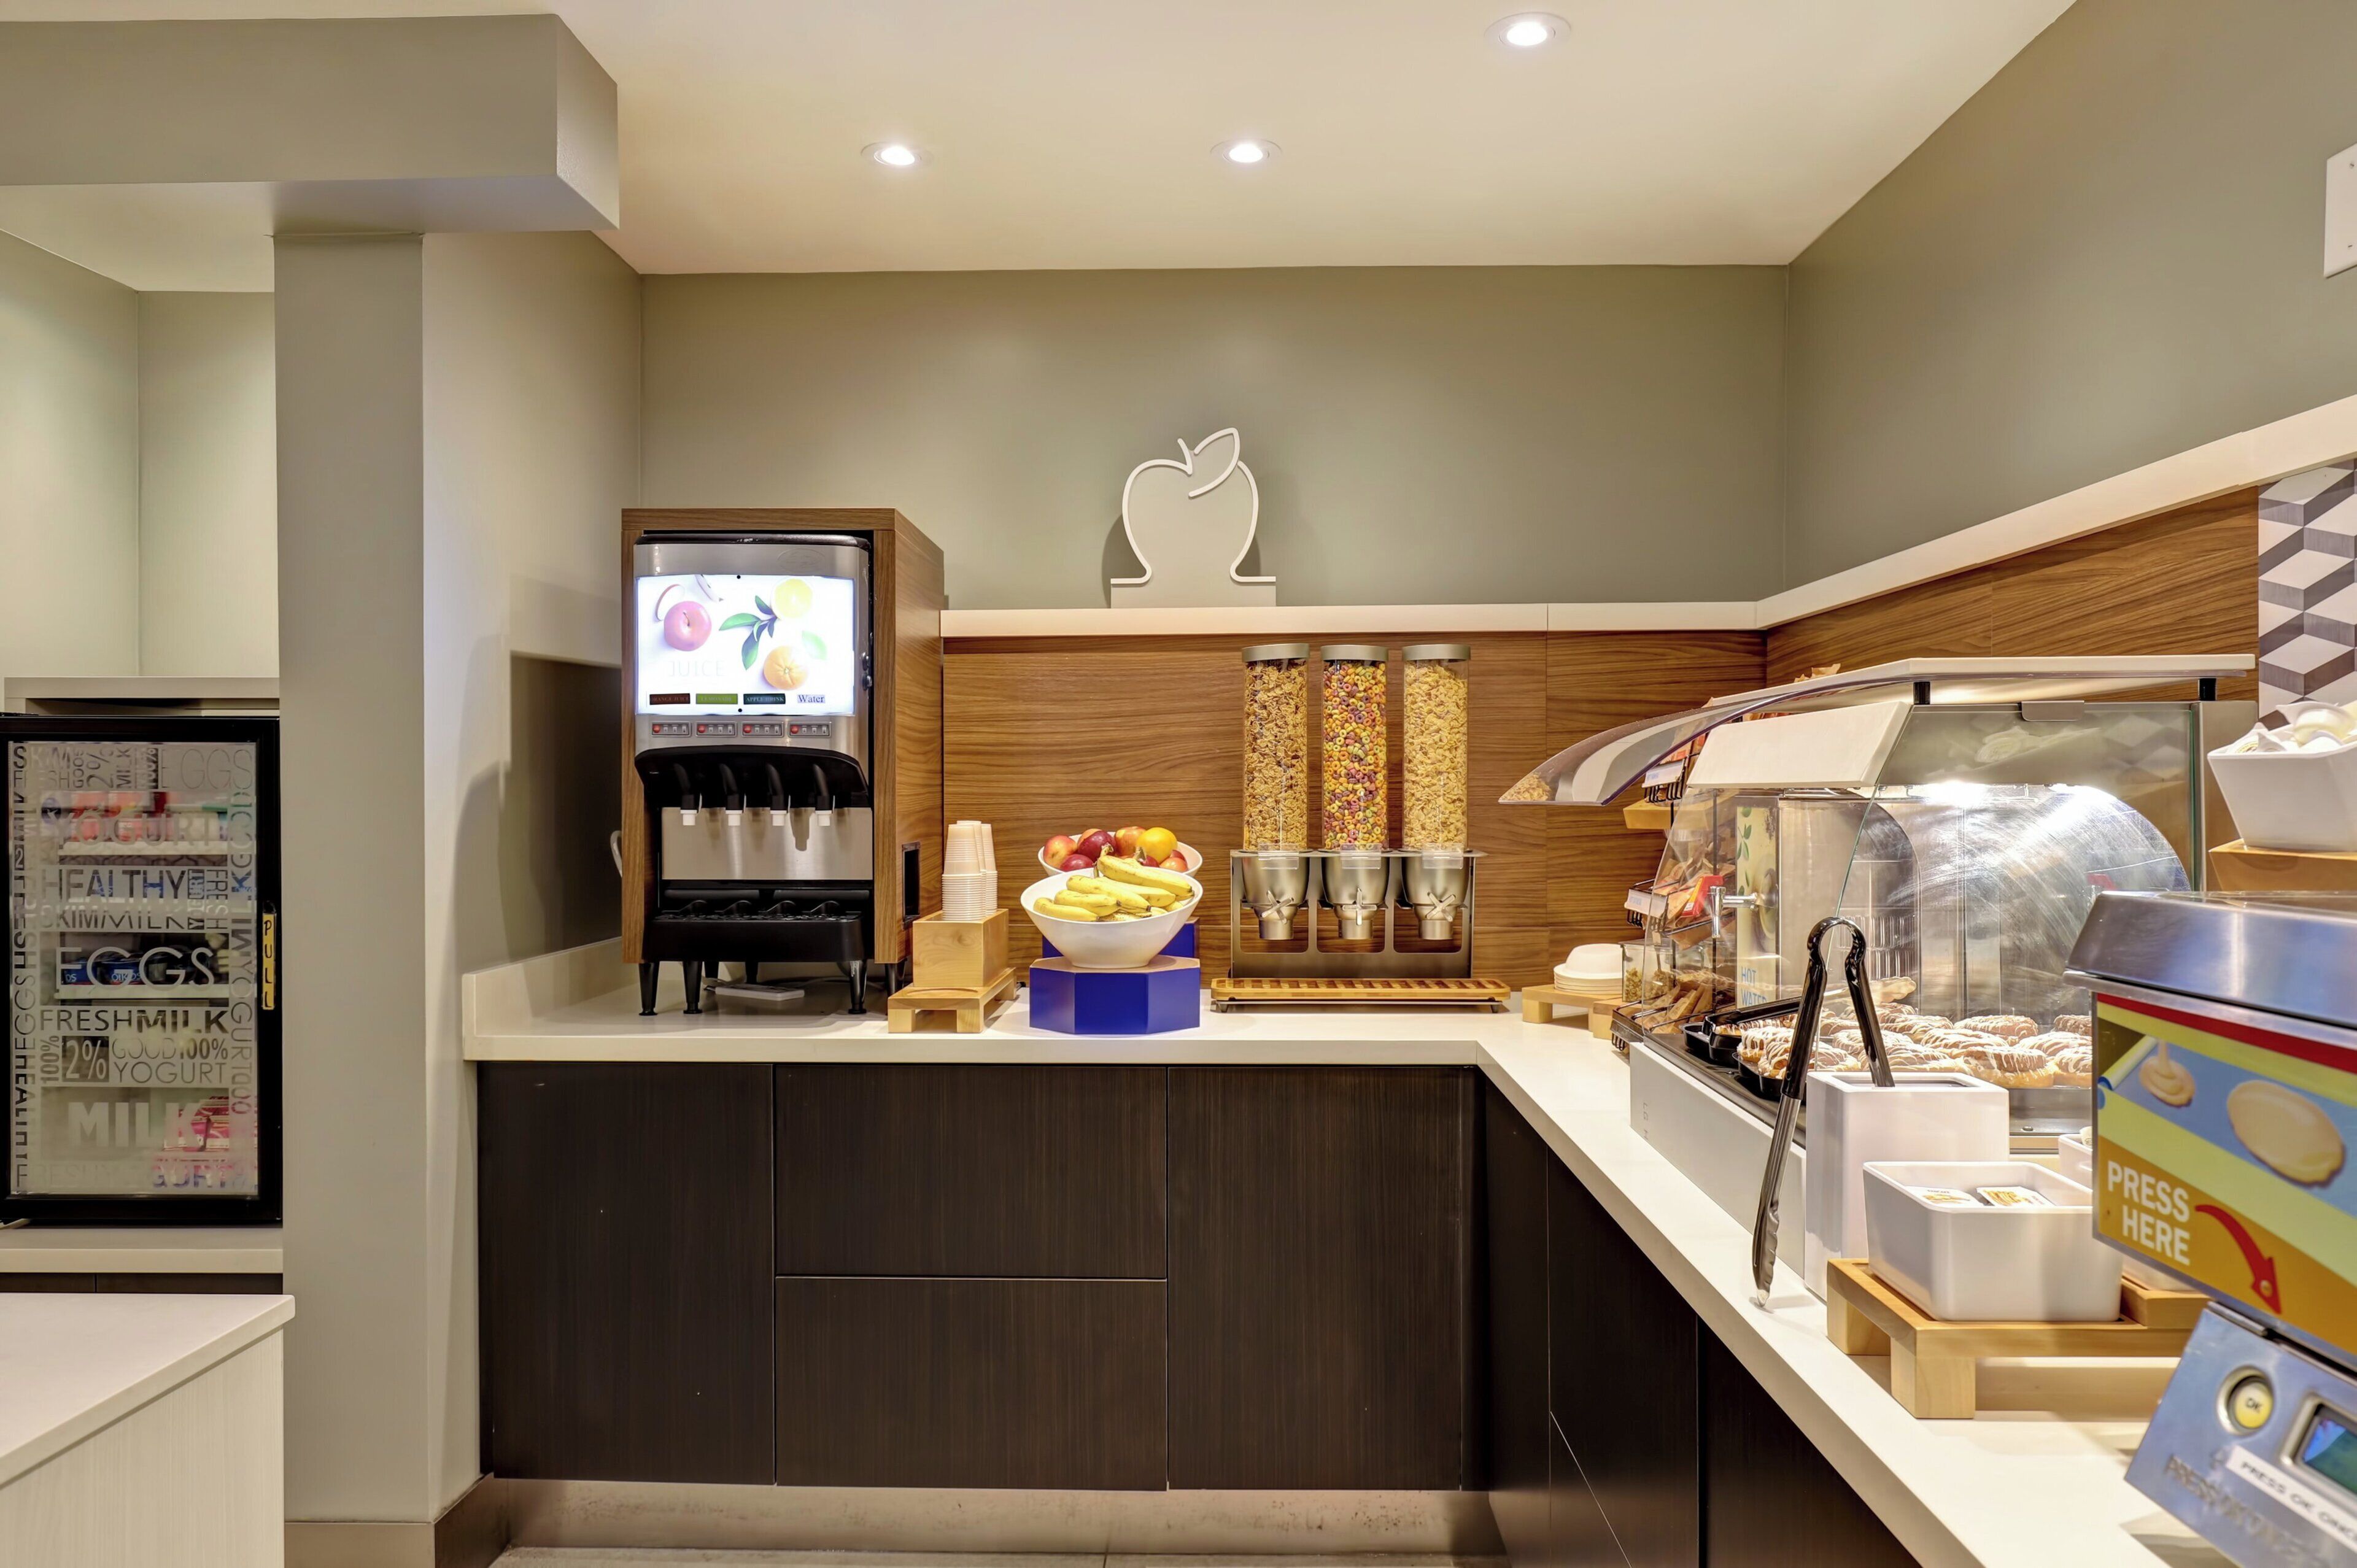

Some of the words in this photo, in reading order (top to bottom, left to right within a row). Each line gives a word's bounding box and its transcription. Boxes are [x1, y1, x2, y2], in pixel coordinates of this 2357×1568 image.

[667, 660, 726, 678] JUICE
[798, 694, 825, 703] Water
[86, 747, 114, 789] 2%
[115, 747, 133, 789] MILK
[160, 748, 254, 790] EGGS
[48, 811, 212, 847] YOGURT
[41, 870, 187, 903] HEALTHY
[188, 870, 205, 929] YURT
[206, 870, 228, 929] FRESH
[56, 946, 214, 992] EGGS
[264, 919, 273, 1008] PULL
[1740, 965, 1757, 987] HOT
[14, 974, 37, 1050] EGGS
[40, 1009, 132, 1032] FRESH
[136, 1010, 230, 1034] MILK
[231, 959, 254, 1073] YOGURT
[40, 1034, 60, 1084] 100%
[64, 1039, 107, 1079] 2%
[112, 1037, 176, 1060] GOOD
[179, 1038, 228, 1060] 100%
[113, 1061, 227, 1084] YOGURT
[68, 1102, 204, 1148] MILK
[2107, 1160, 2190, 1223] PRESS
[2122, 1205, 2190, 1266] HERE
[2244, 1397, 2262, 1415] OK
[2240, 1461, 2288, 1495] PRESS
[2288, 1491, 2315, 1512] OK
